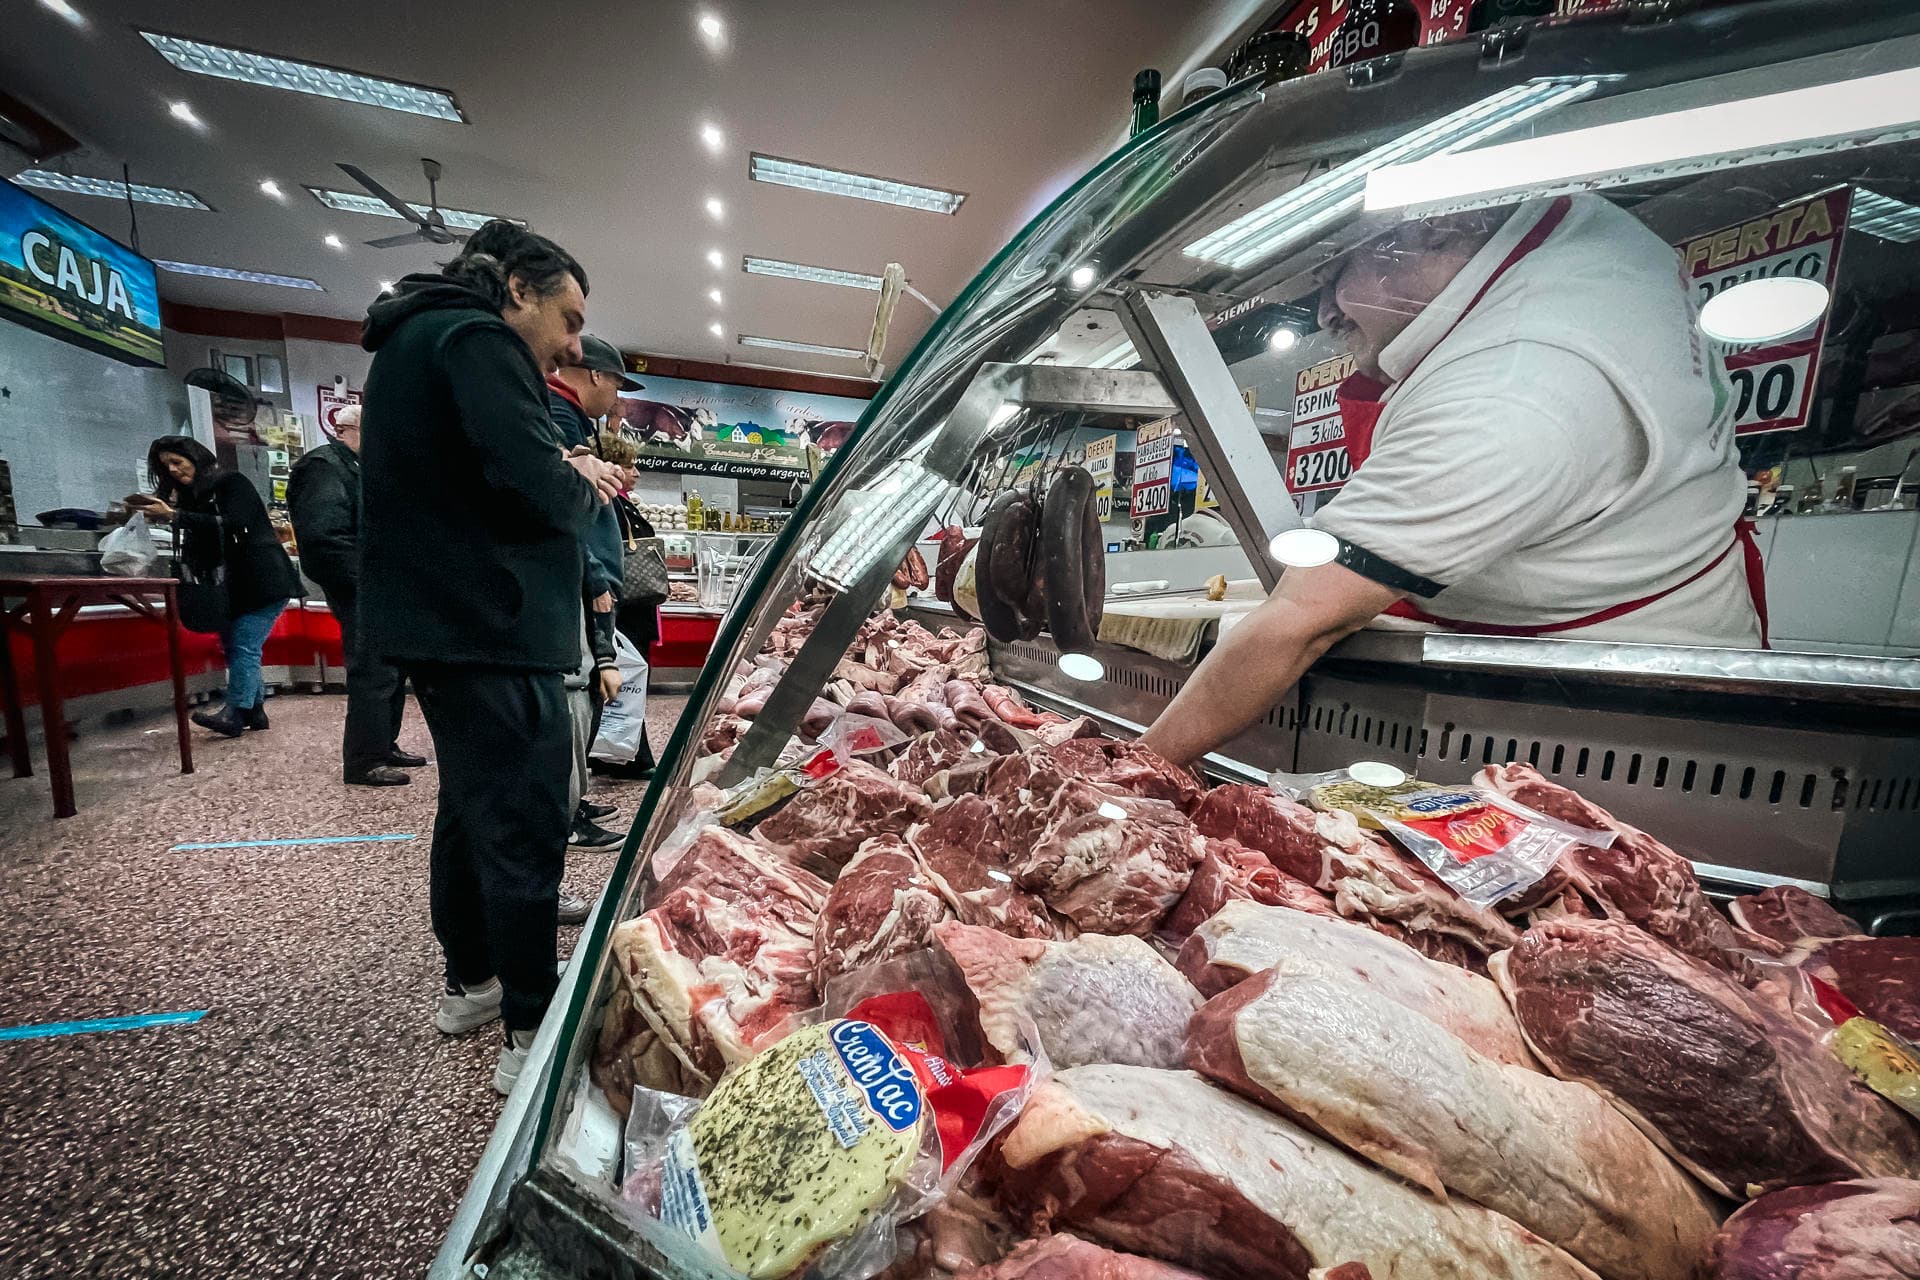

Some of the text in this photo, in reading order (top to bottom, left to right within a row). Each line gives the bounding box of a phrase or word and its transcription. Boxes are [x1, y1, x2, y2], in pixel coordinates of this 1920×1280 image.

[1333, 21, 1380, 68] BBQ
[21, 231, 134, 320] CAJA
[1216, 295, 1266, 326] SIEMP
[1310, 424, 1320, 444] 3
[1087, 439, 1113, 459] OFERTA
[633, 456, 668, 469] mejor
[671, 459, 708, 472] carne,
[710, 462, 728, 473] del
[730, 465, 767, 478] campo
[1296, 447, 1351, 487] 3200
[1137, 485, 1167, 513] 3400
